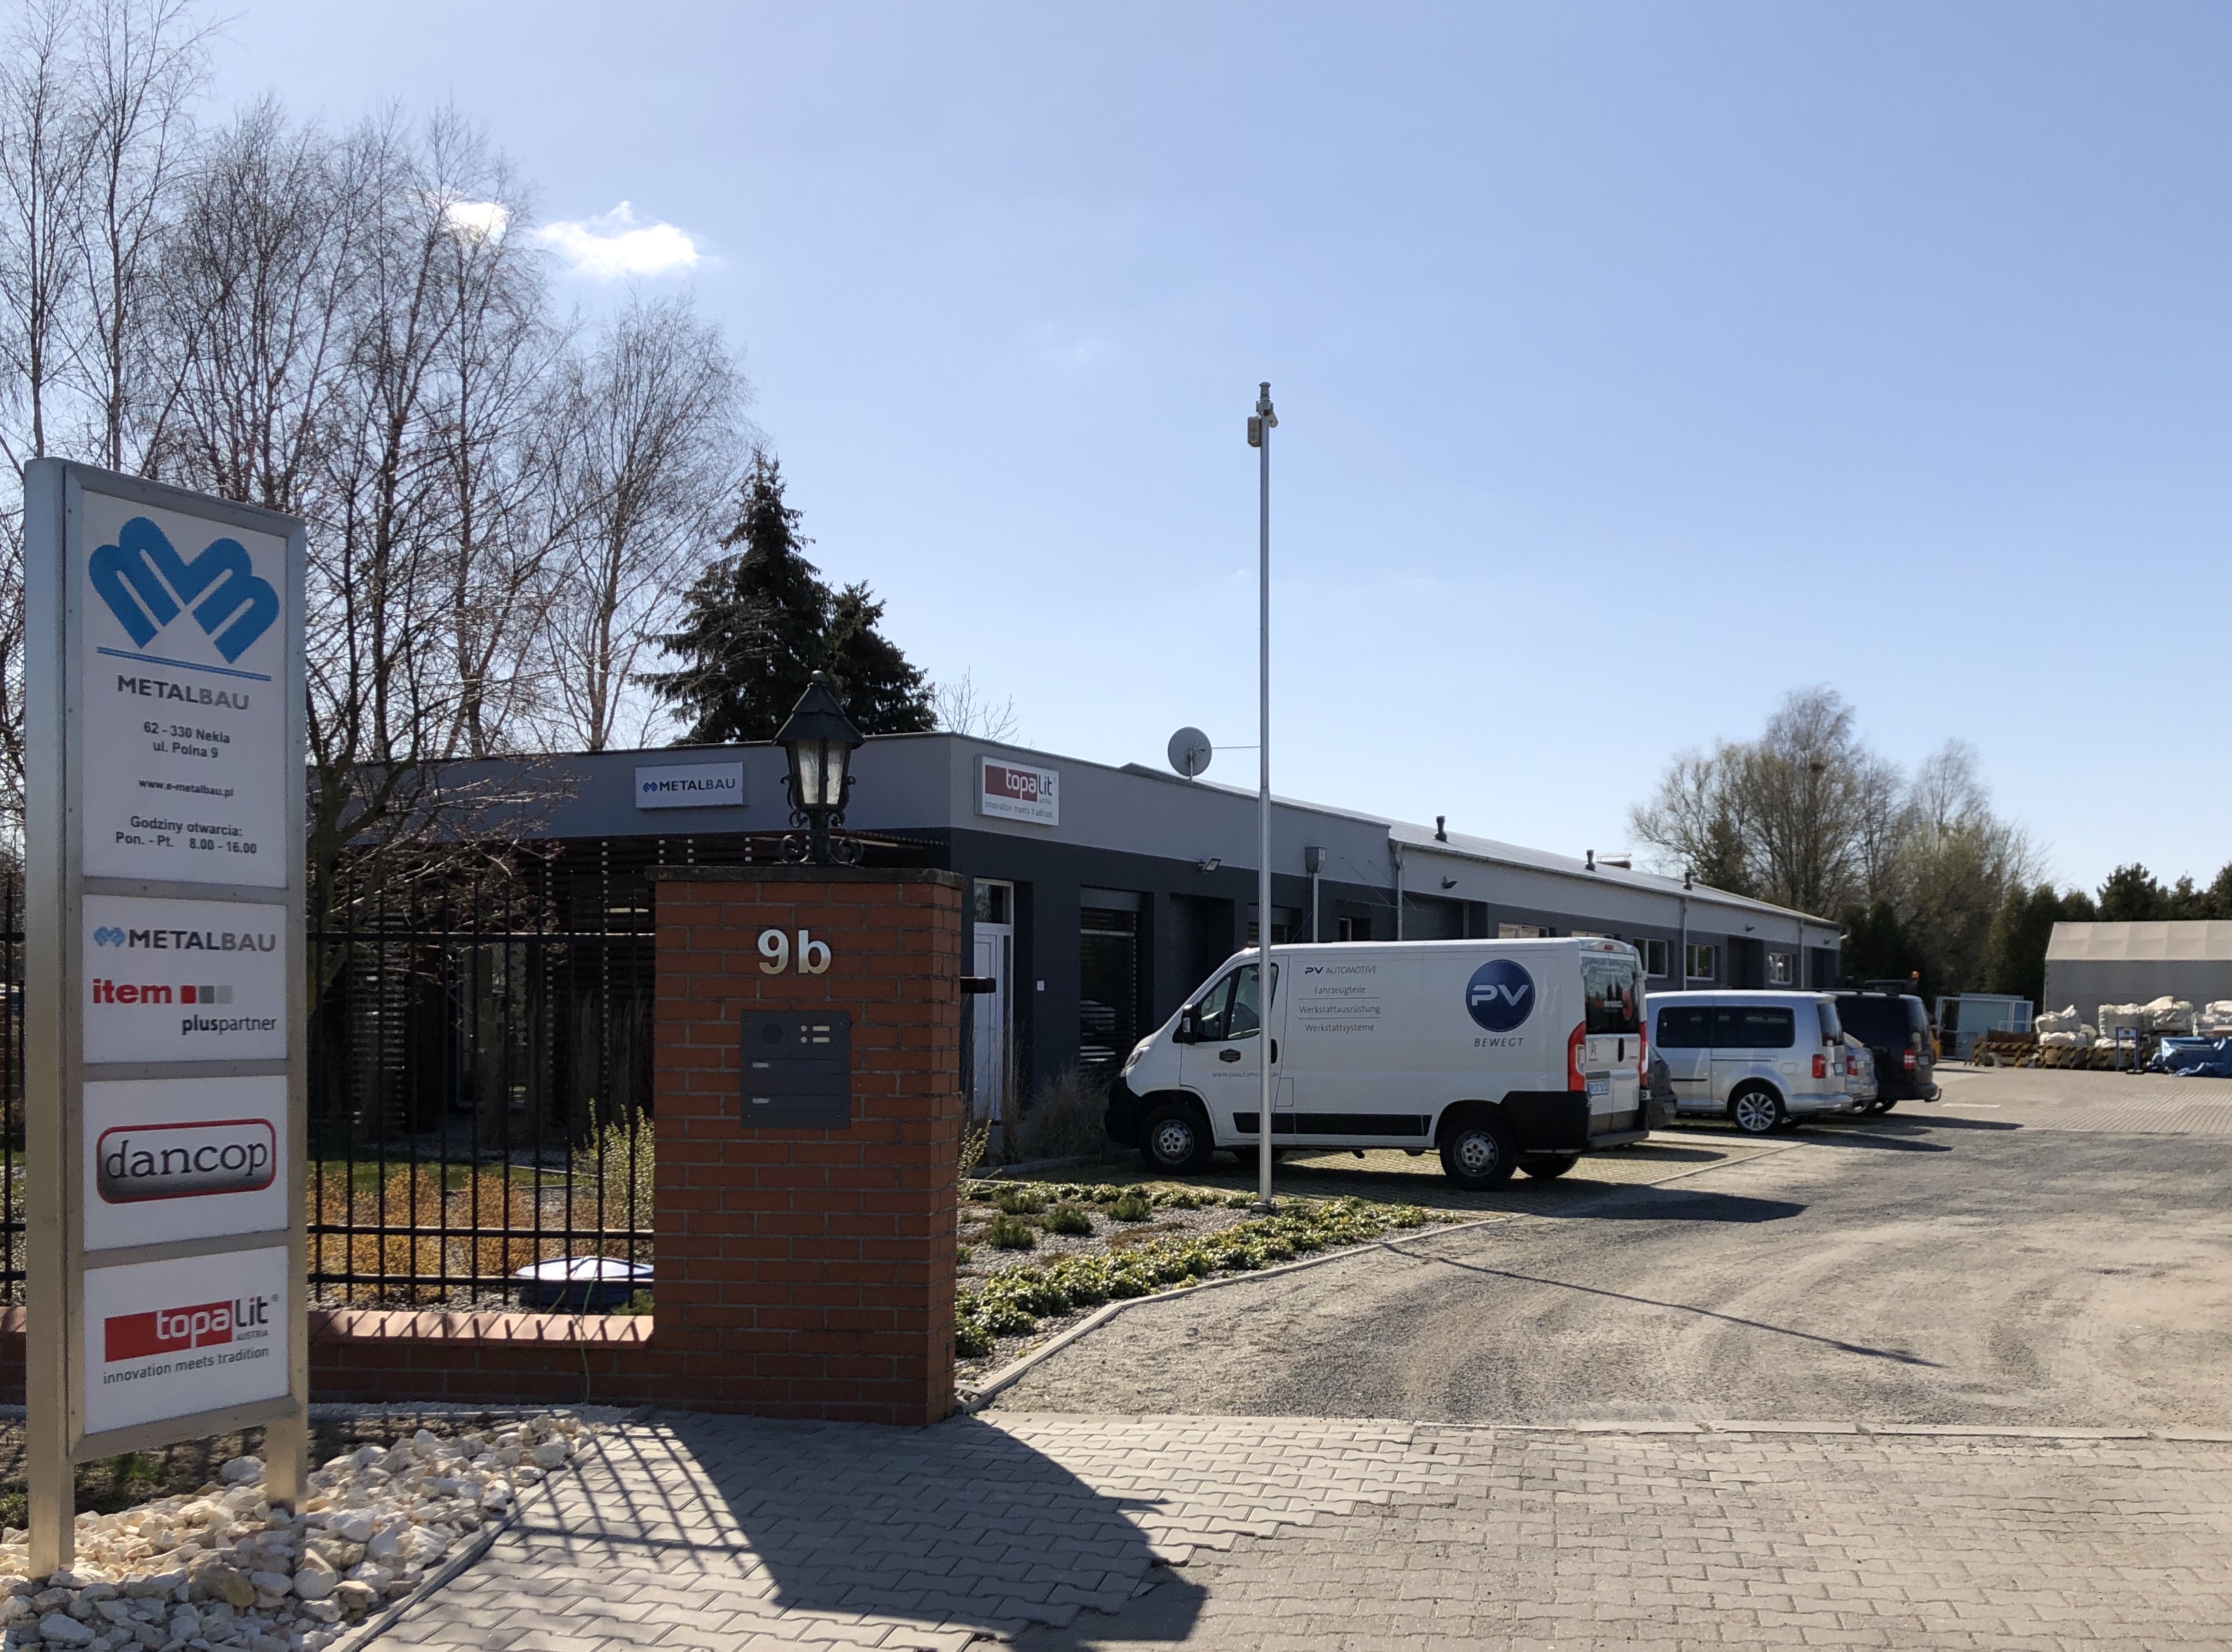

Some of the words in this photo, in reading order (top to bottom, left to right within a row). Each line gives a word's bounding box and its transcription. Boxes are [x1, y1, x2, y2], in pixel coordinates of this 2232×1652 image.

[117, 675, 250, 710] METALBAU
[144, 721, 159, 734] 62
[170, 725, 192, 738] 330
[196, 728, 230, 744] Nekla
[153, 740, 168, 753] ul.
[172, 742, 207, 757] Polna
[211, 747, 218, 758] 9
[138, 779, 234, 798] www.e-metalbau.pl
[659, 778, 736, 792] METALBAU
[1014, 805, 1030, 815] meets
[130, 815, 183, 834] Godziny
[187, 822, 243, 837] otwarcia:
[116, 832, 145, 845] Pon.
[157, 835, 174, 847] Pt.
[190, 838, 214, 850] 8.00
[226, 841, 257, 854] 16.00
[128, 929, 276, 952] METALBAU
[757, 929, 832, 974] 9b
[1305, 966, 1323, 974] PV
[1326, 965, 1377, 974] AUTOMOTIVE
[93, 978, 172, 1004] item
[1314, 985, 1366, 995] Fahrzeugteile
[1471, 985, 1529, 1006] PV
[1299, 1005, 1381, 1015] Werkstattausrüstung
[181, 1014, 277, 1035] pluspartner
[1306, 1023, 1374, 1034] Werkstattsysteme
[1474, 1038, 1524, 1047] BEWEGT
[106, 1139, 267, 1179] dancop
[236, 1329, 269, 1341] AUSTRIA
[104, 1363, 171, 1385] innovation
[175, 1356, 214, 1372] meets
[218, 1347, 269, 1364] tradition
